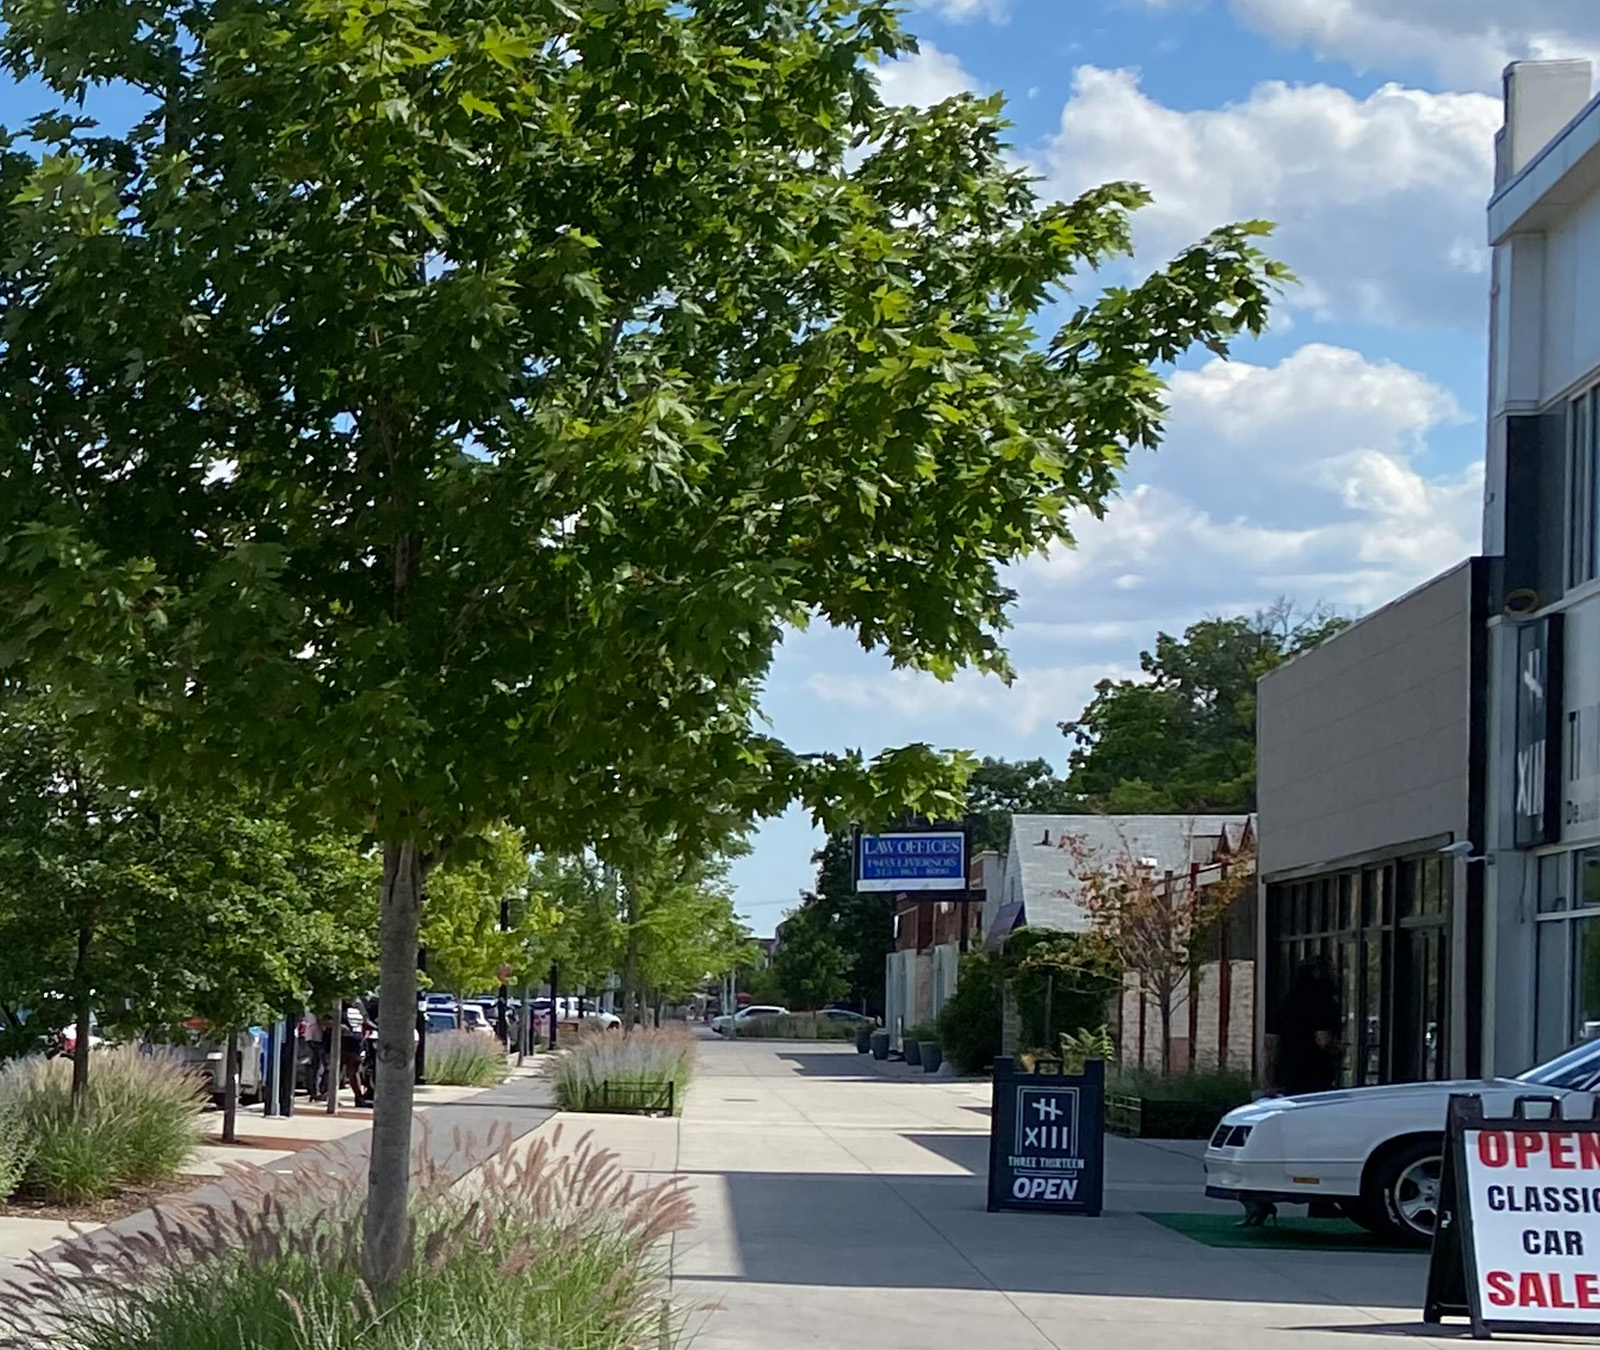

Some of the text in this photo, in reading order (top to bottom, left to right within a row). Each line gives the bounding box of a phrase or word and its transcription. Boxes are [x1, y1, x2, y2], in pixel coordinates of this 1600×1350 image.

[865, 839, 960, 855] LAW OFFICES
[1008, 1155, 1085, 1169] THREE THIRTEEN
[1478, 1130, 1600, 1169] OPEN
[1013, 1177, 1078, 1200] OPEN
[1522, 1229, 1584, 1256] CAR
[1486, 1270, 1600, 1309] SALE
